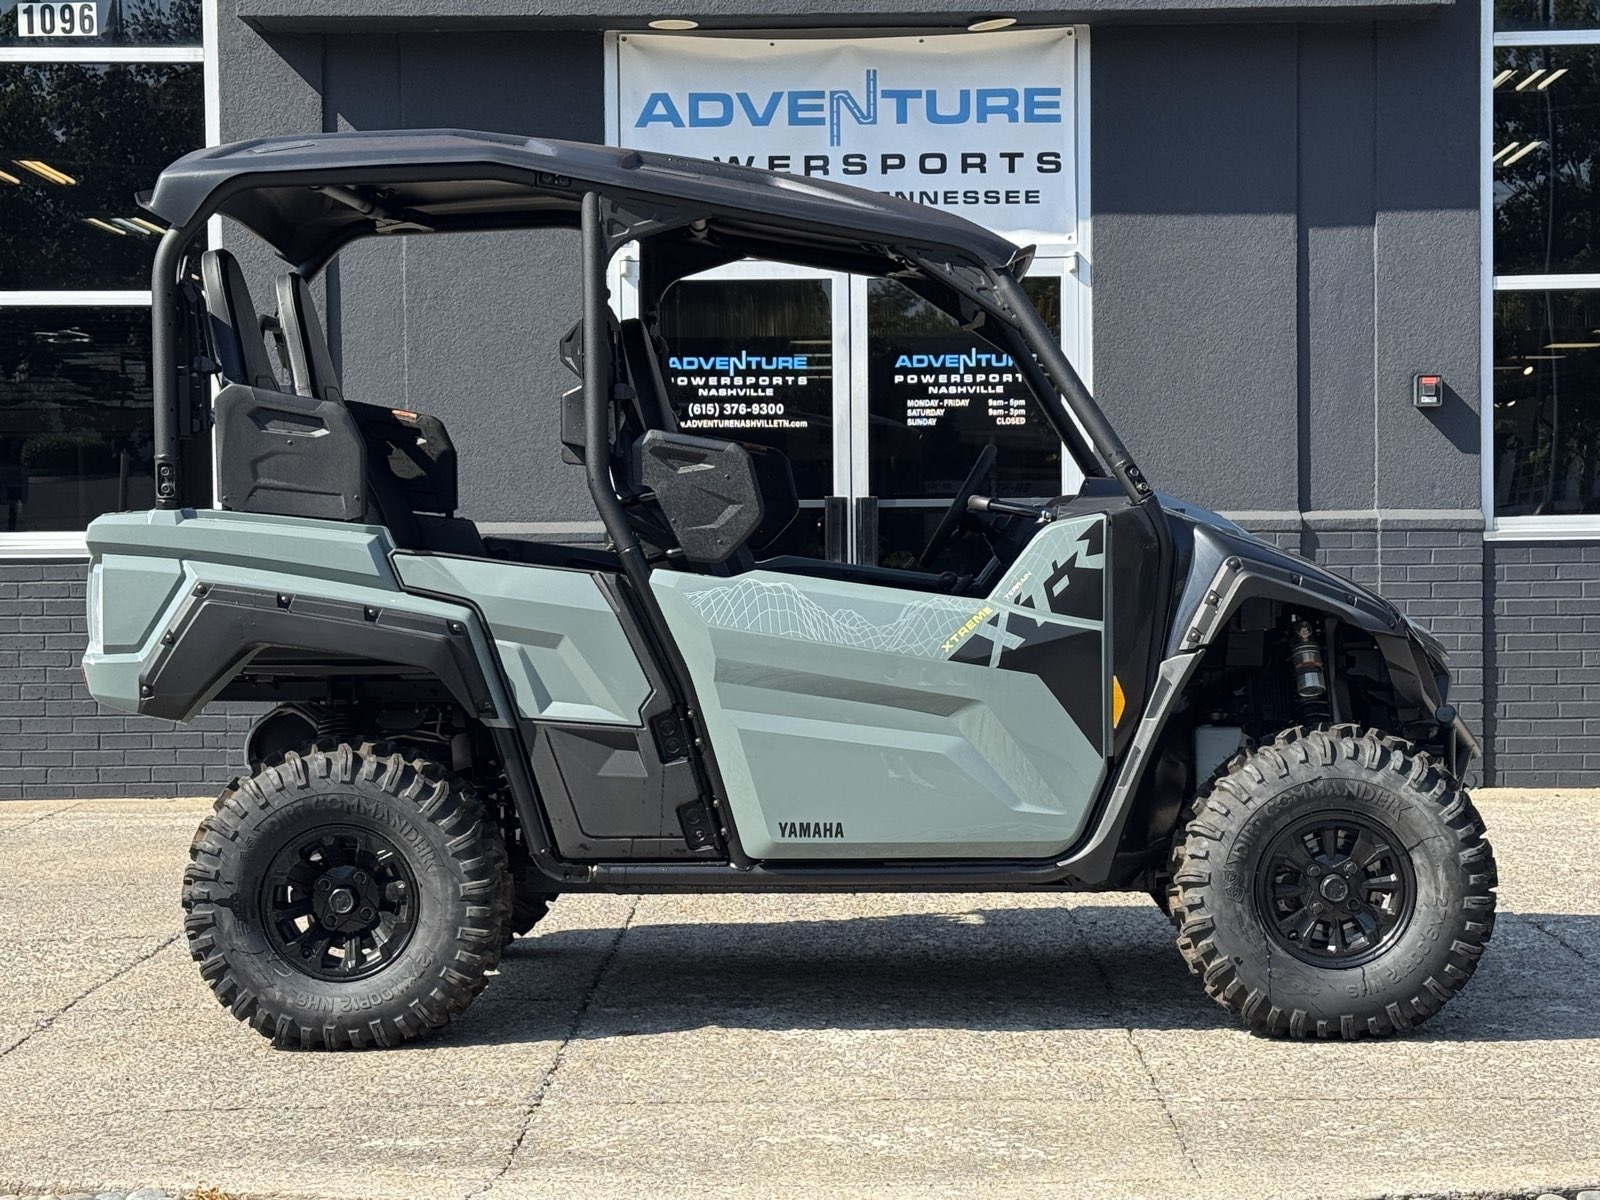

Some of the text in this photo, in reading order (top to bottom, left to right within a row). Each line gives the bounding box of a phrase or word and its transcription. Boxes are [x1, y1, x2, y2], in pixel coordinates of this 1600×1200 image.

[22, 4, 94, 34] 1096
[634, 69, 1062, 147] ADVENTURE
[713, 151, 1062, 177] ERSPORTS
[878, 189, 1041, 206] NNESSEE
[669, 350, 808, 377] ADVENTURE
[895, 347, 1037, 374] ADVENTU
[671, 376, 808, 386] OWERSPORTS
[894, 373, 1023, 384] POWERSPORT
[698, 387, 774, 397] NASHVILLE
[928, 385, 1004, 395] NASHVILLE
[688, 402, 785, 418] (615) 376-9300
[906, 398, 940, 408] MONDAY
[943, 398, 970, 407] FRIDAY
[988, 398, 1004, 407] 9am
[906, 408, 945, 417] SATURDAY
[988, 407, 1004, 416] 9am
[906, 416, 1026, 426] SUNDAY CLOSED
[941, 571, 1032, 653] XTREME TERRAIN
[1263, 780, 1400, 817] COMMANDER
[312, 795, 437, 867] COMMANDER
[778, 822, 845, 838] YAMAHA
